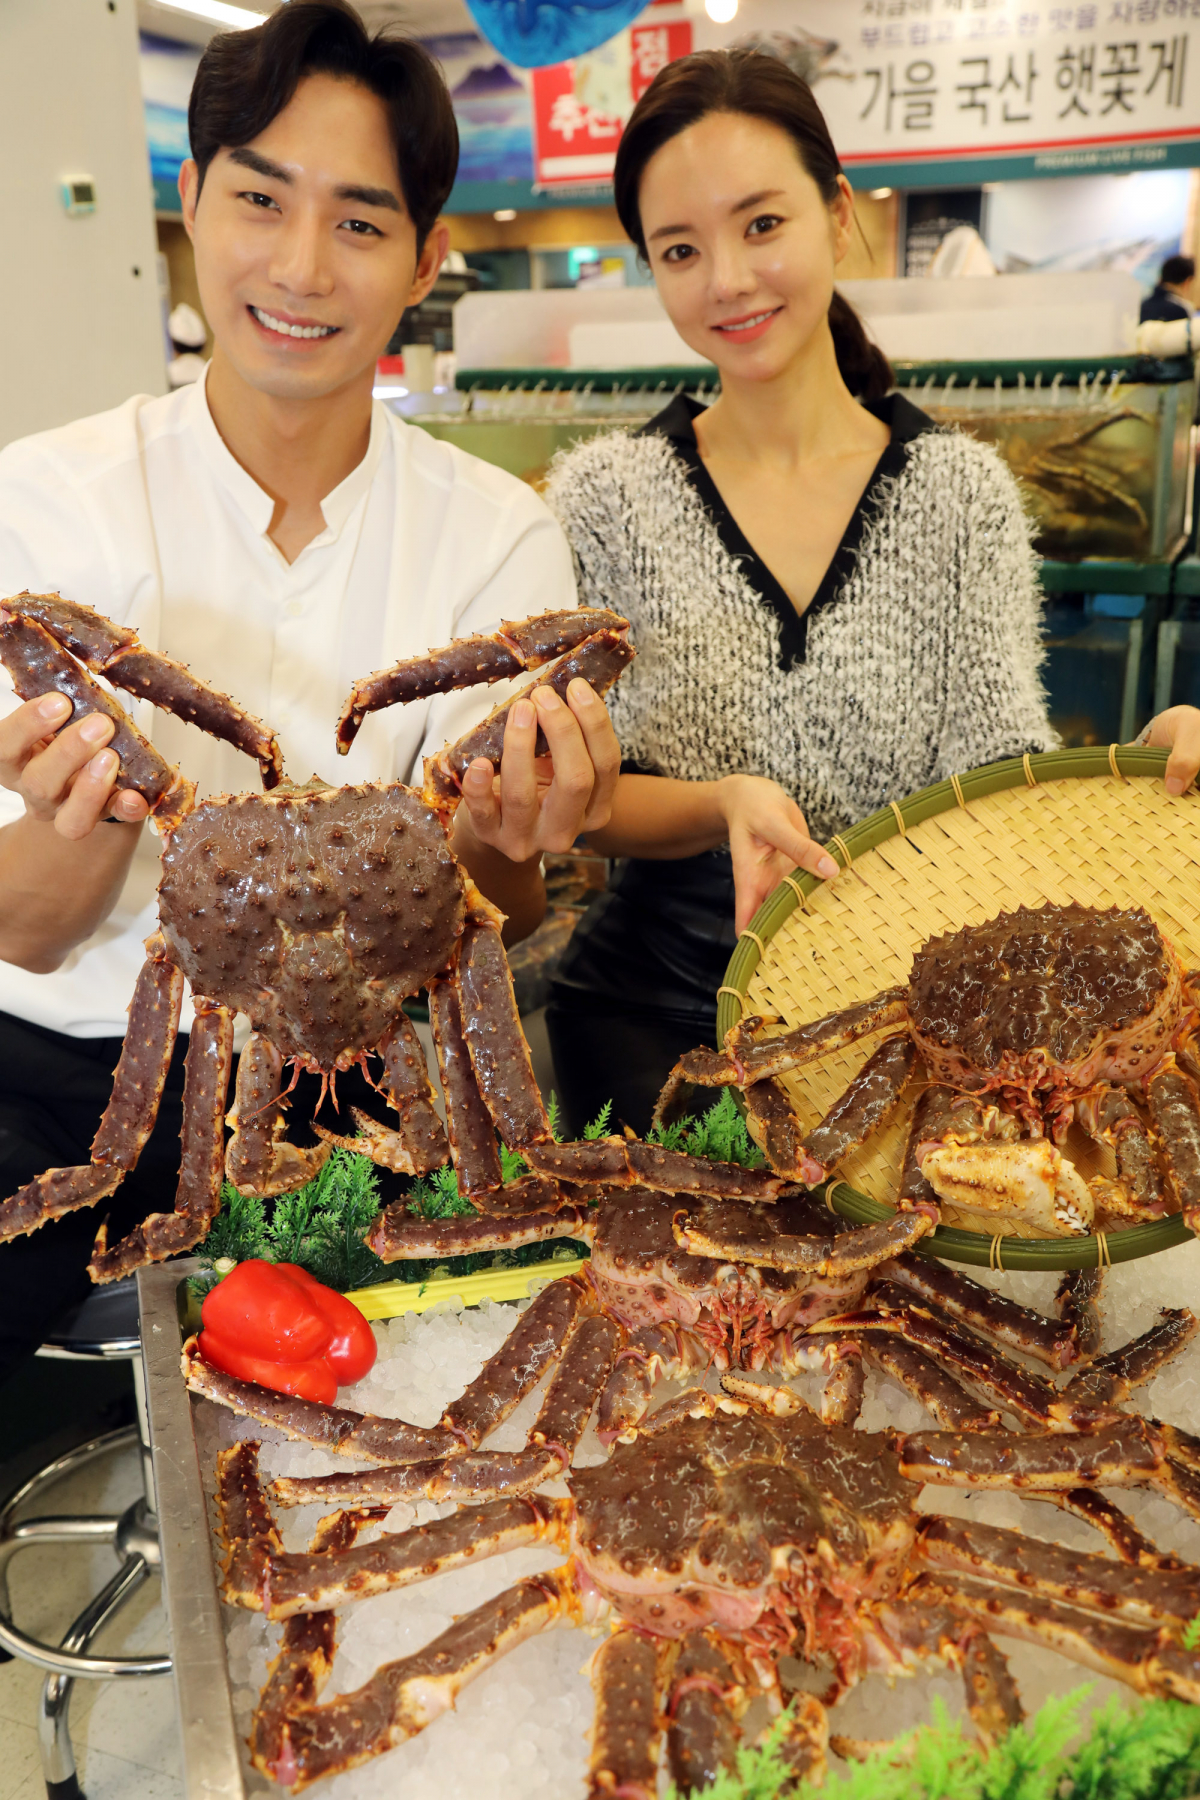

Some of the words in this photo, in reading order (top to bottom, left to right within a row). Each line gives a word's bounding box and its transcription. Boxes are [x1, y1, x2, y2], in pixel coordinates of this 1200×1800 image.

[860, 60, 938, 132] 가을
[956, 50, 1036, 127] 국산
[1056, 35, 1189, 119] 햇꽃게
